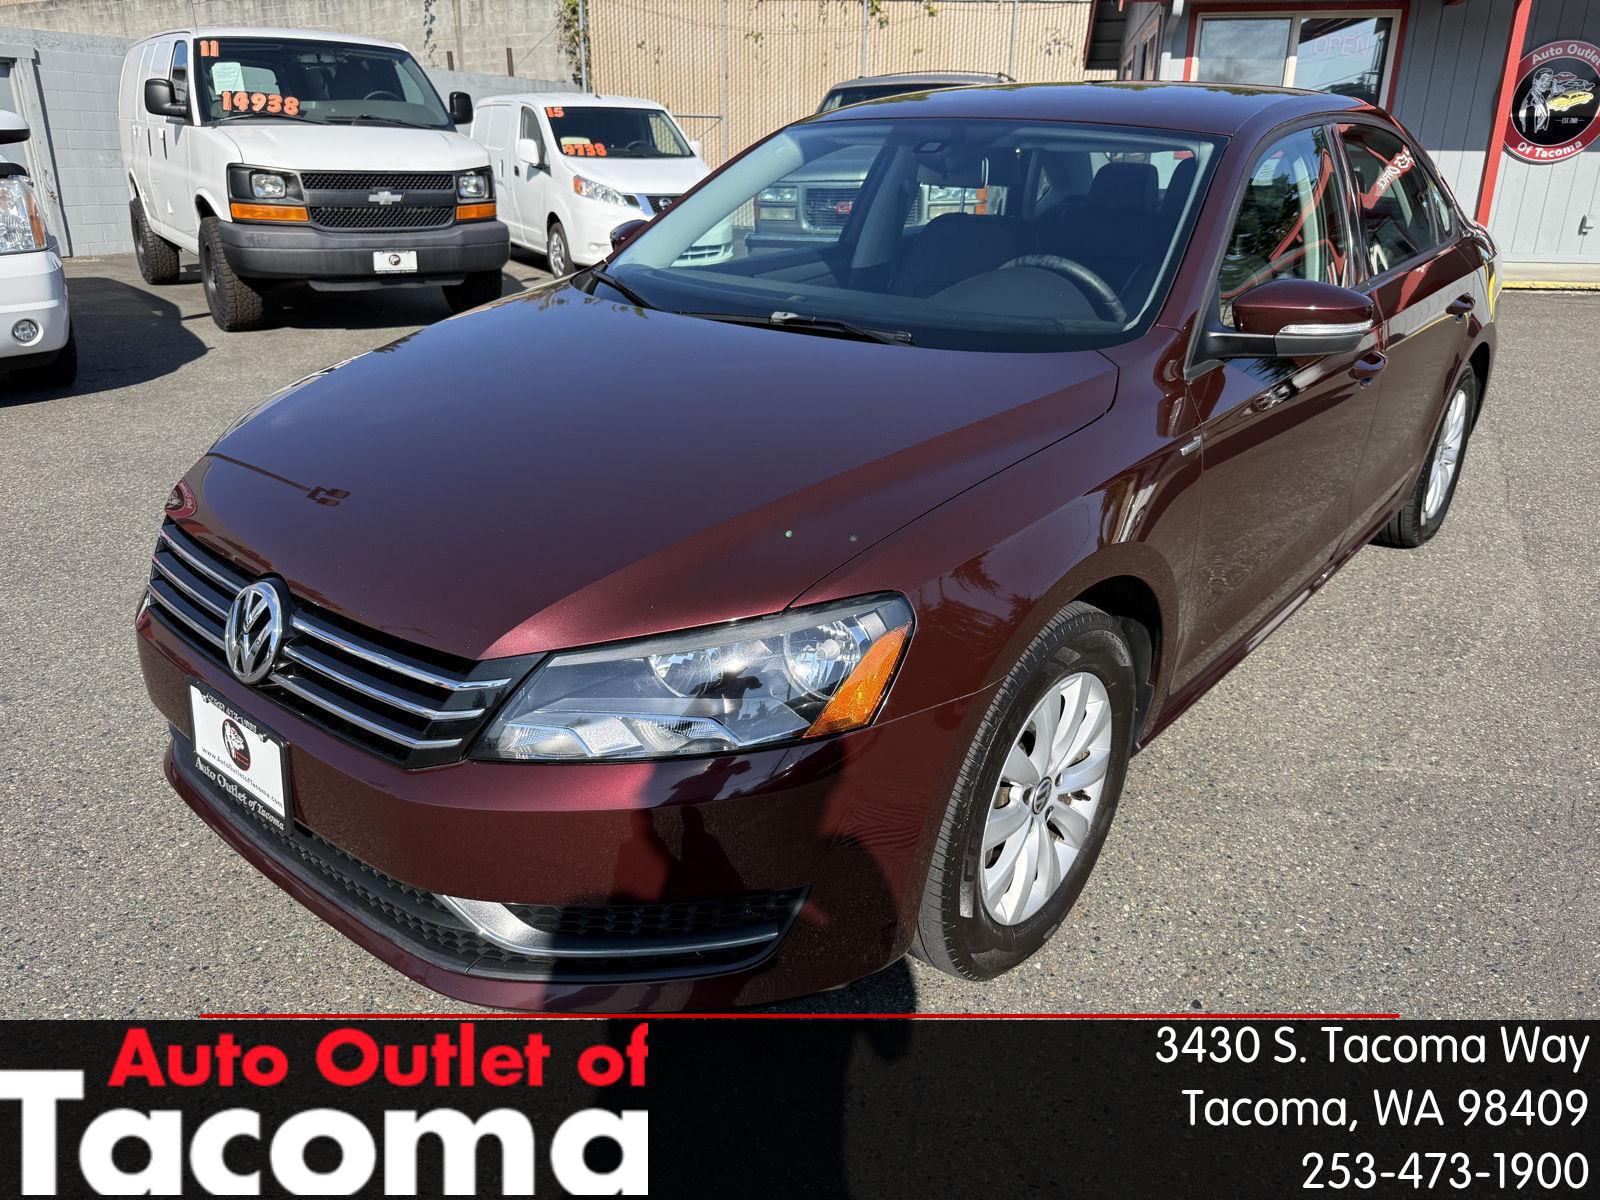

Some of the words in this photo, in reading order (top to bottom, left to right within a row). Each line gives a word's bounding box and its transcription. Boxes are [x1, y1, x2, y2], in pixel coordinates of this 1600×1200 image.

[200, 40, 219, 57] 11
[1312, 35, 1371, 56] OPEN
[1532, 47, 1563, 65] Auto
[221, 91, 299, 116] 14938
[546, 106, 565, 118] 15
[1517, 142, 1534, 154] Of
[1535, 141, 1582, 158] Tacoma
[195, 756, 217, 781] Auto
[218, 773, 248, 805] Outlet
[248, 800, 257, 811] of
[257, 803, 285, 831] Tacoma
